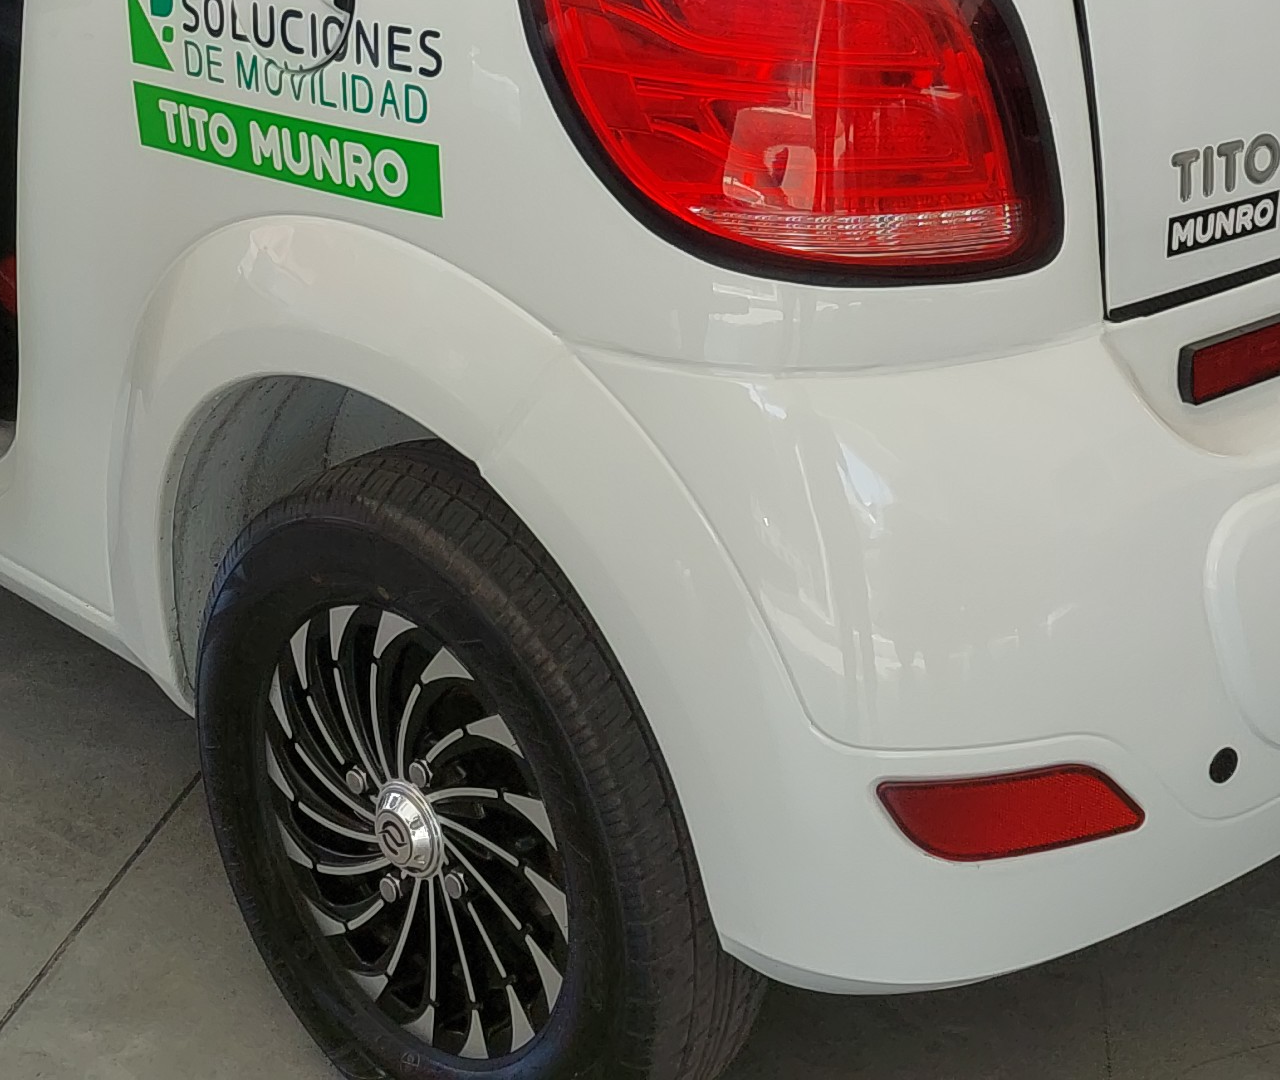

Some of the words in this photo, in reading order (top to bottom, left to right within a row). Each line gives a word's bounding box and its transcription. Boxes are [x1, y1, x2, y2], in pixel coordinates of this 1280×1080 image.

[184, 40, 225, 84] DE
[235, 50, 428, 125] MOVILIDAD
[158, 98, 238, 158] TITO
[250, 119, 409, 198] MUNRO
[1171, 133, 1280, 203] TITO
[1171, 198, 1275, 251] MUNRO
